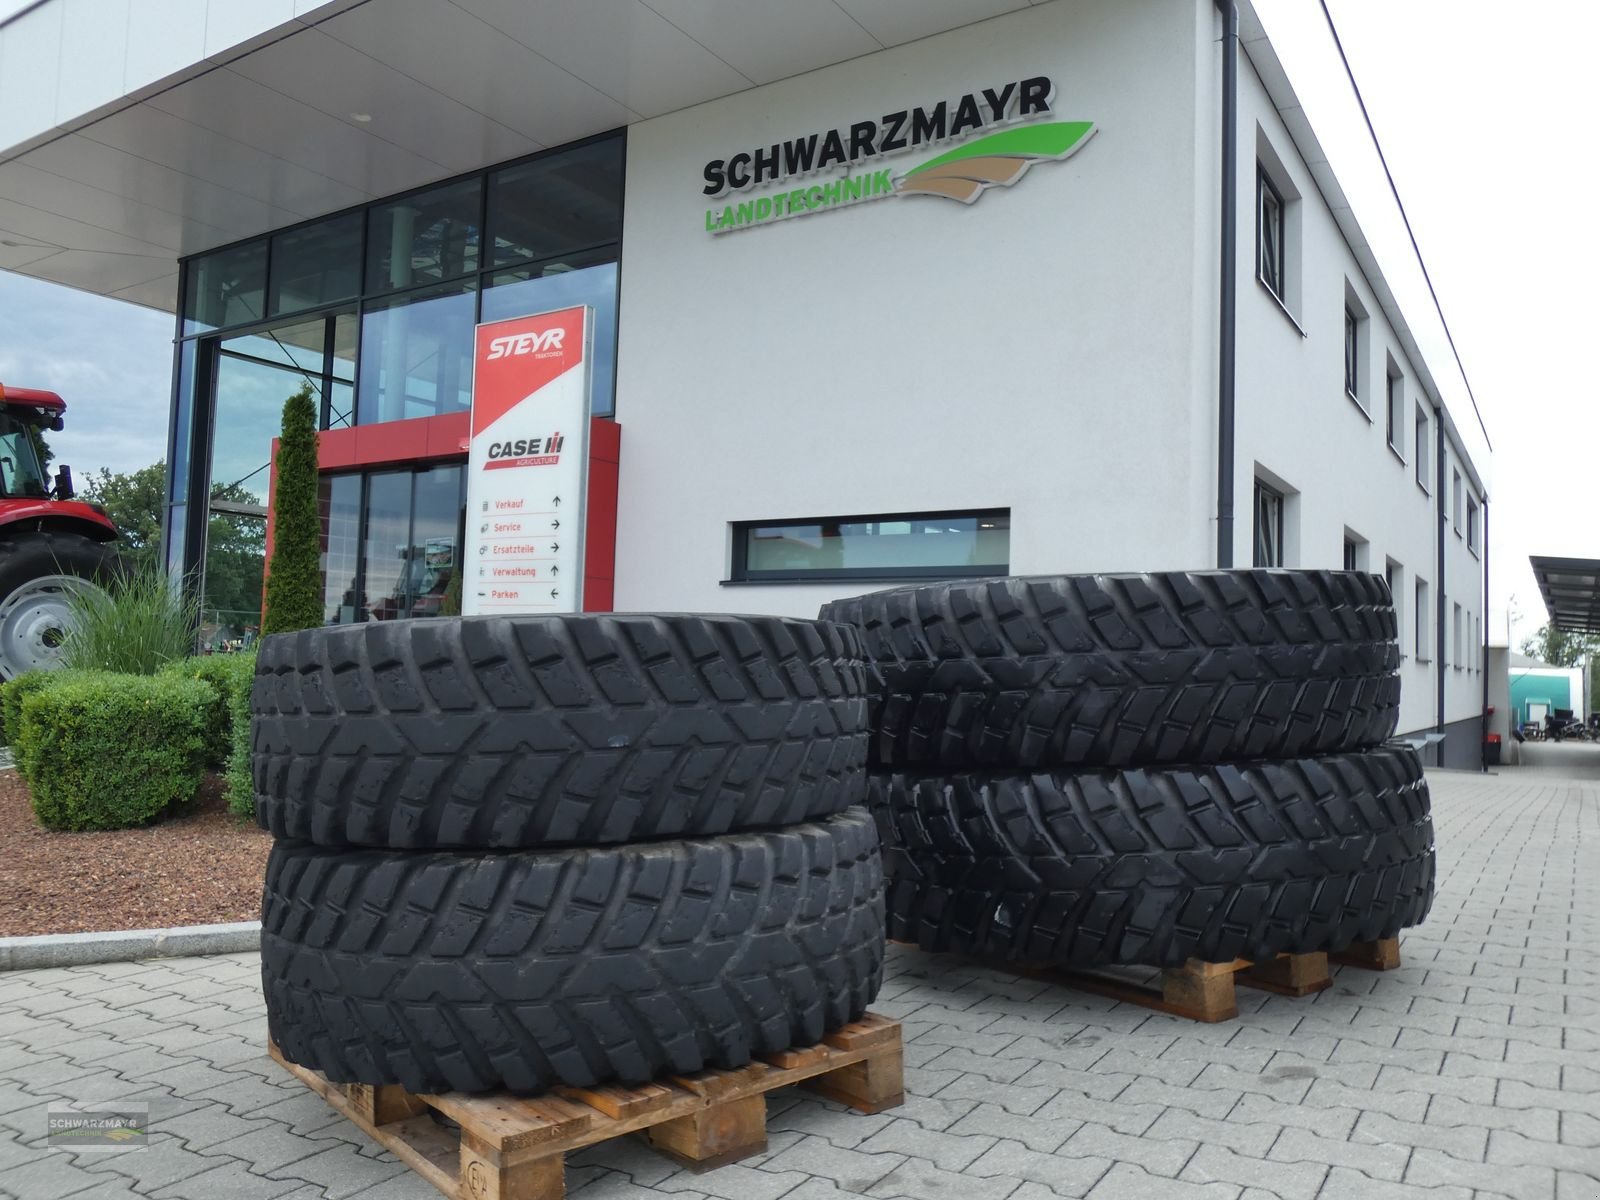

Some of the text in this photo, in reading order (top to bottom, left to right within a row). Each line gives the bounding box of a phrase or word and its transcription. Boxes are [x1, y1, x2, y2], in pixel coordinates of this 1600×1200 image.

[703, 76, 1052, 196] SCHWARZMAYR
[706, 168, 893, 232] LANDTECHNIK
[487, 327, 566, 360] STEYR
[488, 438, 541, 459] CASE
[516, 456, 557, 466] AGRICULTURE
[495, 499, 524, 509] Verkauf
[494, 523, 521, 532] Service
[493, 544, 535, 554] Ersatzteile
[492, 567, 536, 577] Verwaltung
[491, 590, 519, 599] Parken
